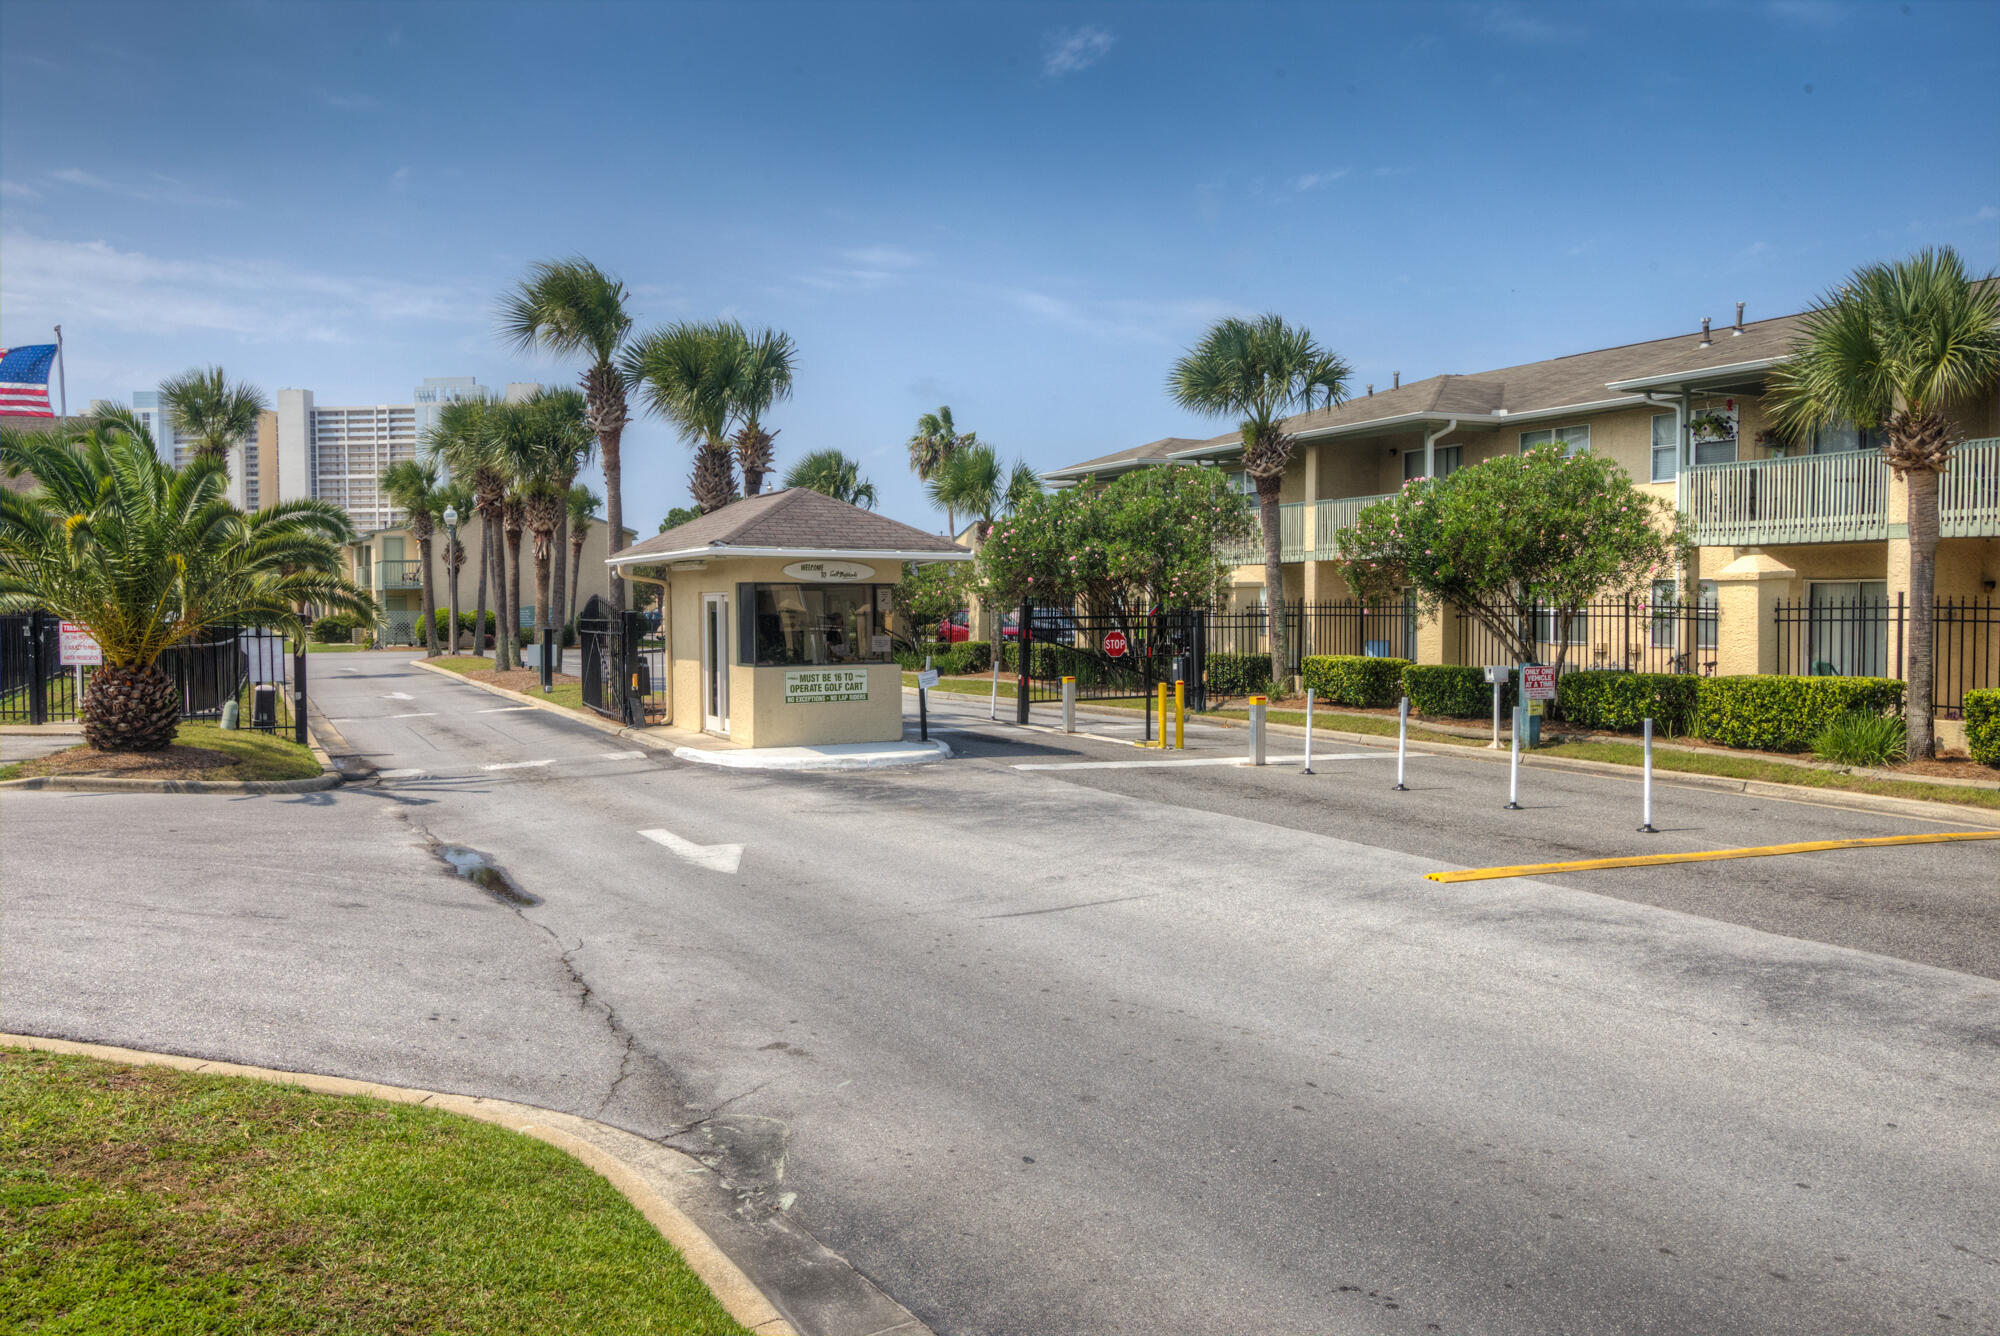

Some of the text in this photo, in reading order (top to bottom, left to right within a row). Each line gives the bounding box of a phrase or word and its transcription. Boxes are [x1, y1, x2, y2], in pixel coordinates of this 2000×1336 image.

[801, 563, 824, 571] WELCOME
[1105, 639, 1126, 650] STOP
[799, 672, 853, 683] MUST BE 16 TO
[790, 682, 864, 693] OPERATE GOLF CART
